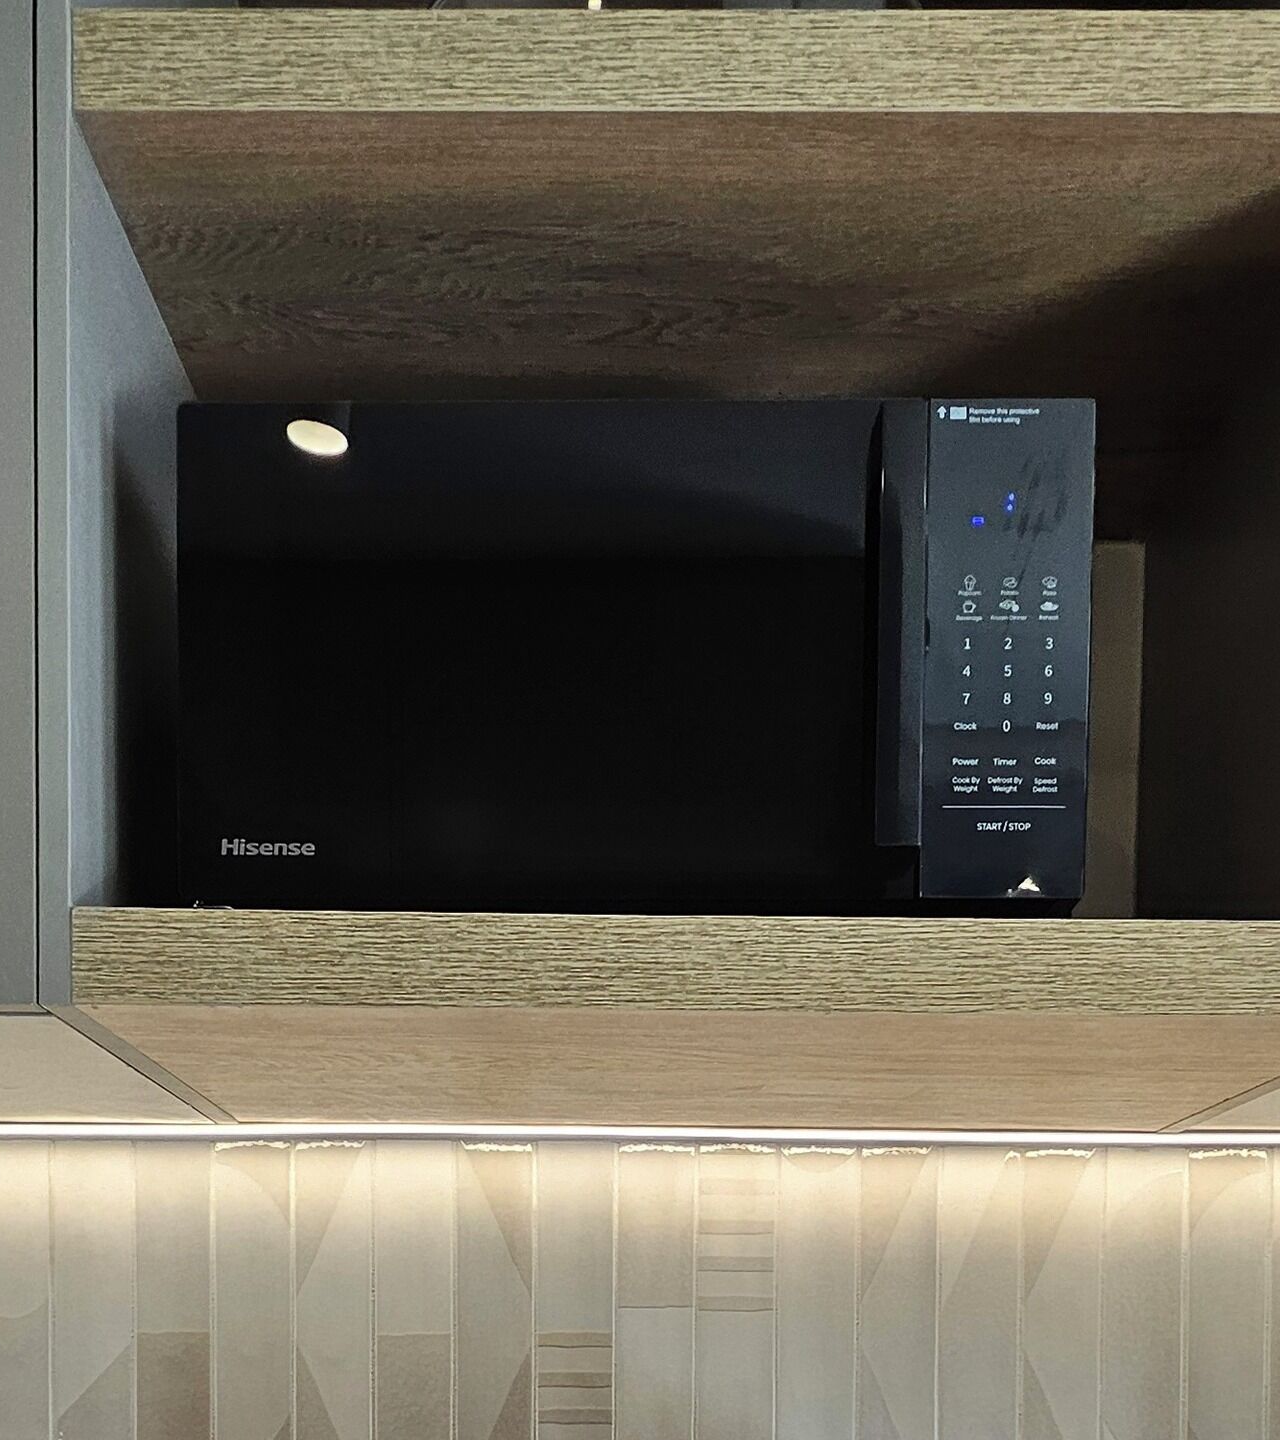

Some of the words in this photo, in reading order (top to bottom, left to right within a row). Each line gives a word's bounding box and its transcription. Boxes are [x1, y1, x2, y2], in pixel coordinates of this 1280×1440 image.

[968, 407, 996, 415] Remove
[1009, 407, 1040, 416] protective
[981, 416, 1002, 424] before
[1003, 416, 1021, 425] using
[963, 637, 971, 650] 1
[1003, 637, 1013, 650] 2
[1045, 637, 1054, 650] 3
[962, 664, 971, 677] 4
[1003, 664, 1012, 677] 5
[1044, 664, 1053, 677] 6
[962, 692, 971, 705] 7
[1003, 692, 1012, 705] 8
[1043, 692, 1053, 705] 9
[953, 721, 977, 731] Clock
[1002, 719, 1011, 732] 0
[1036, 721, 1059, 731] Reset
[952, 757, 979, 766] Power
[992, 757, 1017, 766] Timer
[1034, 757, 1057, 766] Cook
[952, 776, 970, 784] Cook
[971, 776, 981, 785] By
[987, 776, 1013, 784] Defrost
[1013, 776, 1023, 785] By
[1033, 777, 1057, 786] Speed
[953, 785, 978, 794] Weight
[992, 785, 1018, 794] Weight
[221, 838, 316, 857] Hisense
